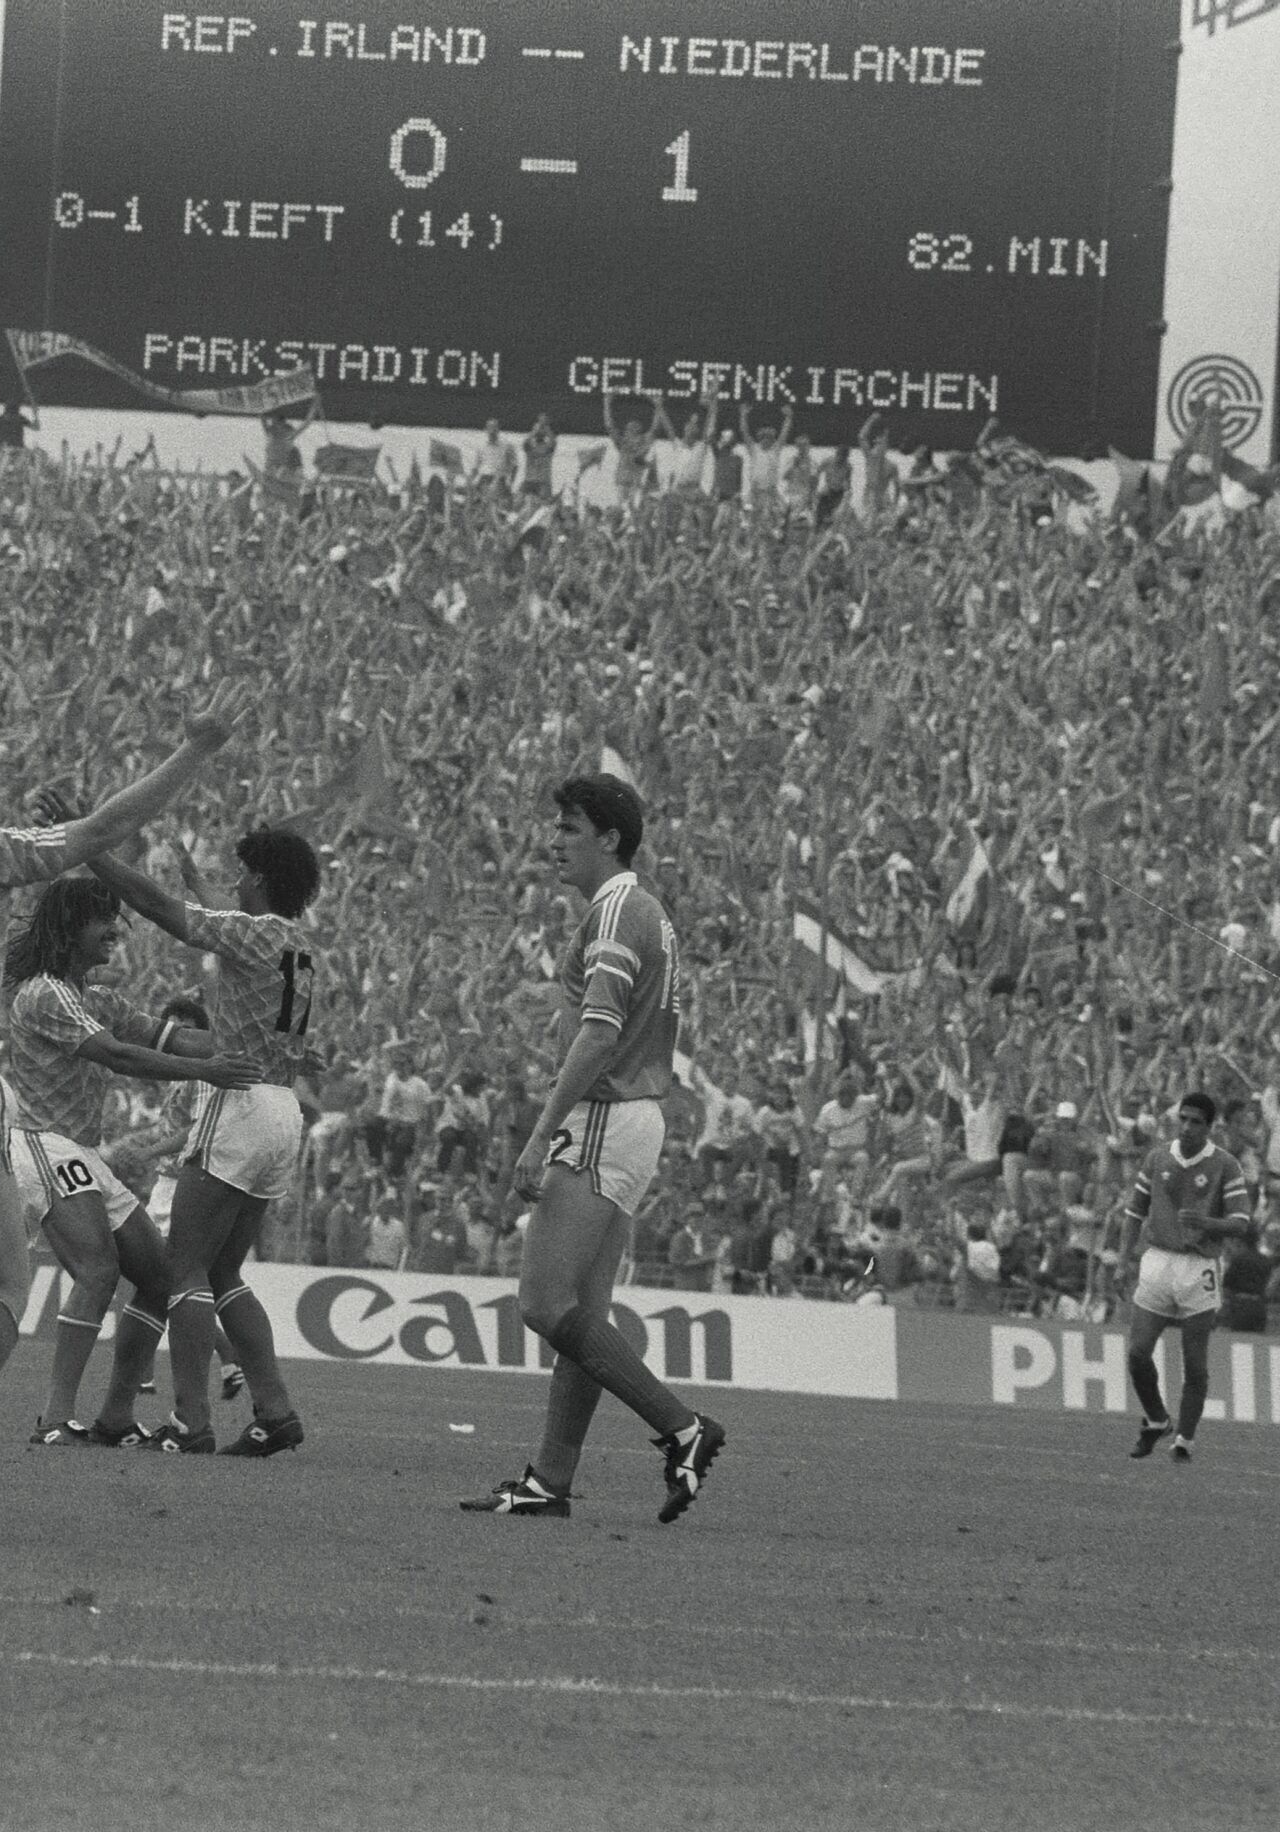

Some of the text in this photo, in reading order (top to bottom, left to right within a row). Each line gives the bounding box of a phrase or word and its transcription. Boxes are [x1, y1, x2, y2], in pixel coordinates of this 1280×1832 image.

[161, 14, 487, 65] REP.IRLAND
[620, 35, 985, 85] NIEDERLANDE
[389, 118, 447, 188] 0
[661, 130, 698, 202] 1
[184, 198, 345, 242] KIEFT
[389, 208, 503, 250] (14)
[908, 232, 1108, 277] 82.MIN
[142, 333, 999, 412] PARKSTADION GELSENKIRCHEN
[56, 1159, 94, 1193] 10
[1201, 1268, 1216, 1292] 3
